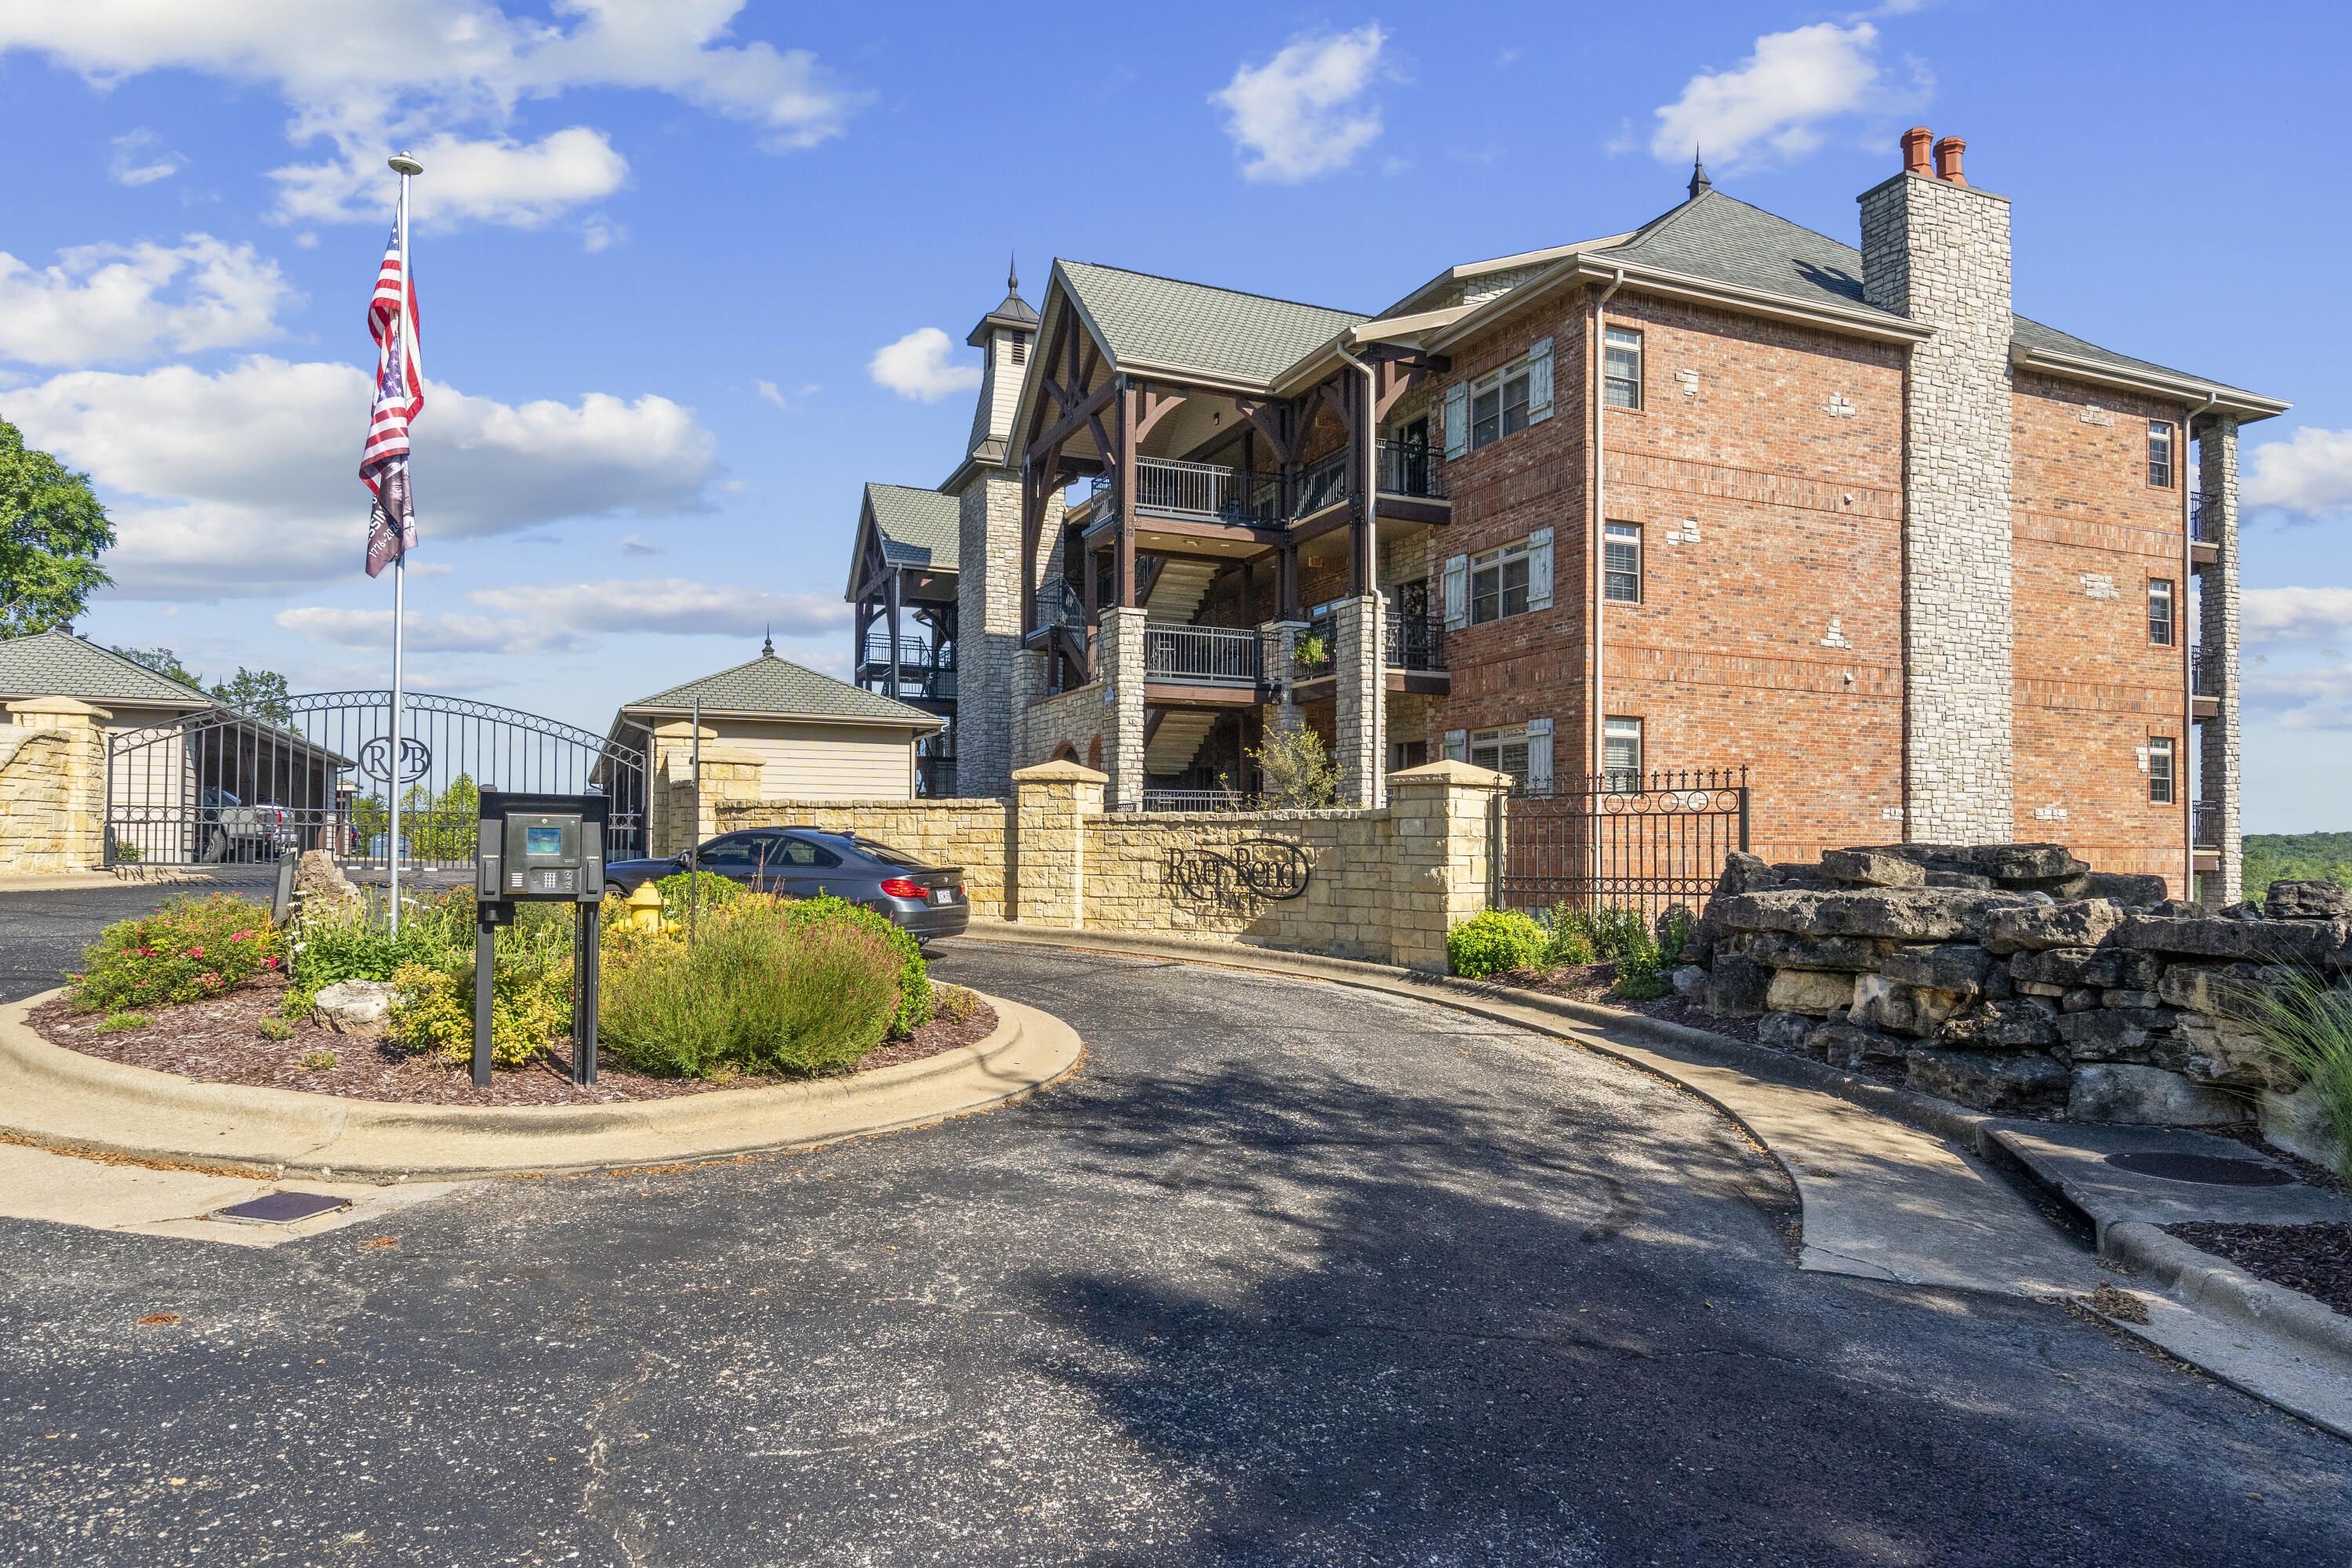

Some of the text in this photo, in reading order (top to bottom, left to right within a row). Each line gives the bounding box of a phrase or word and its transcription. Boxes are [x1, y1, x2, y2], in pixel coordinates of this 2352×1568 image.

[1167, 848, 1299, 889] River Bend
[1210, 891, 1260, 911] PLACE
